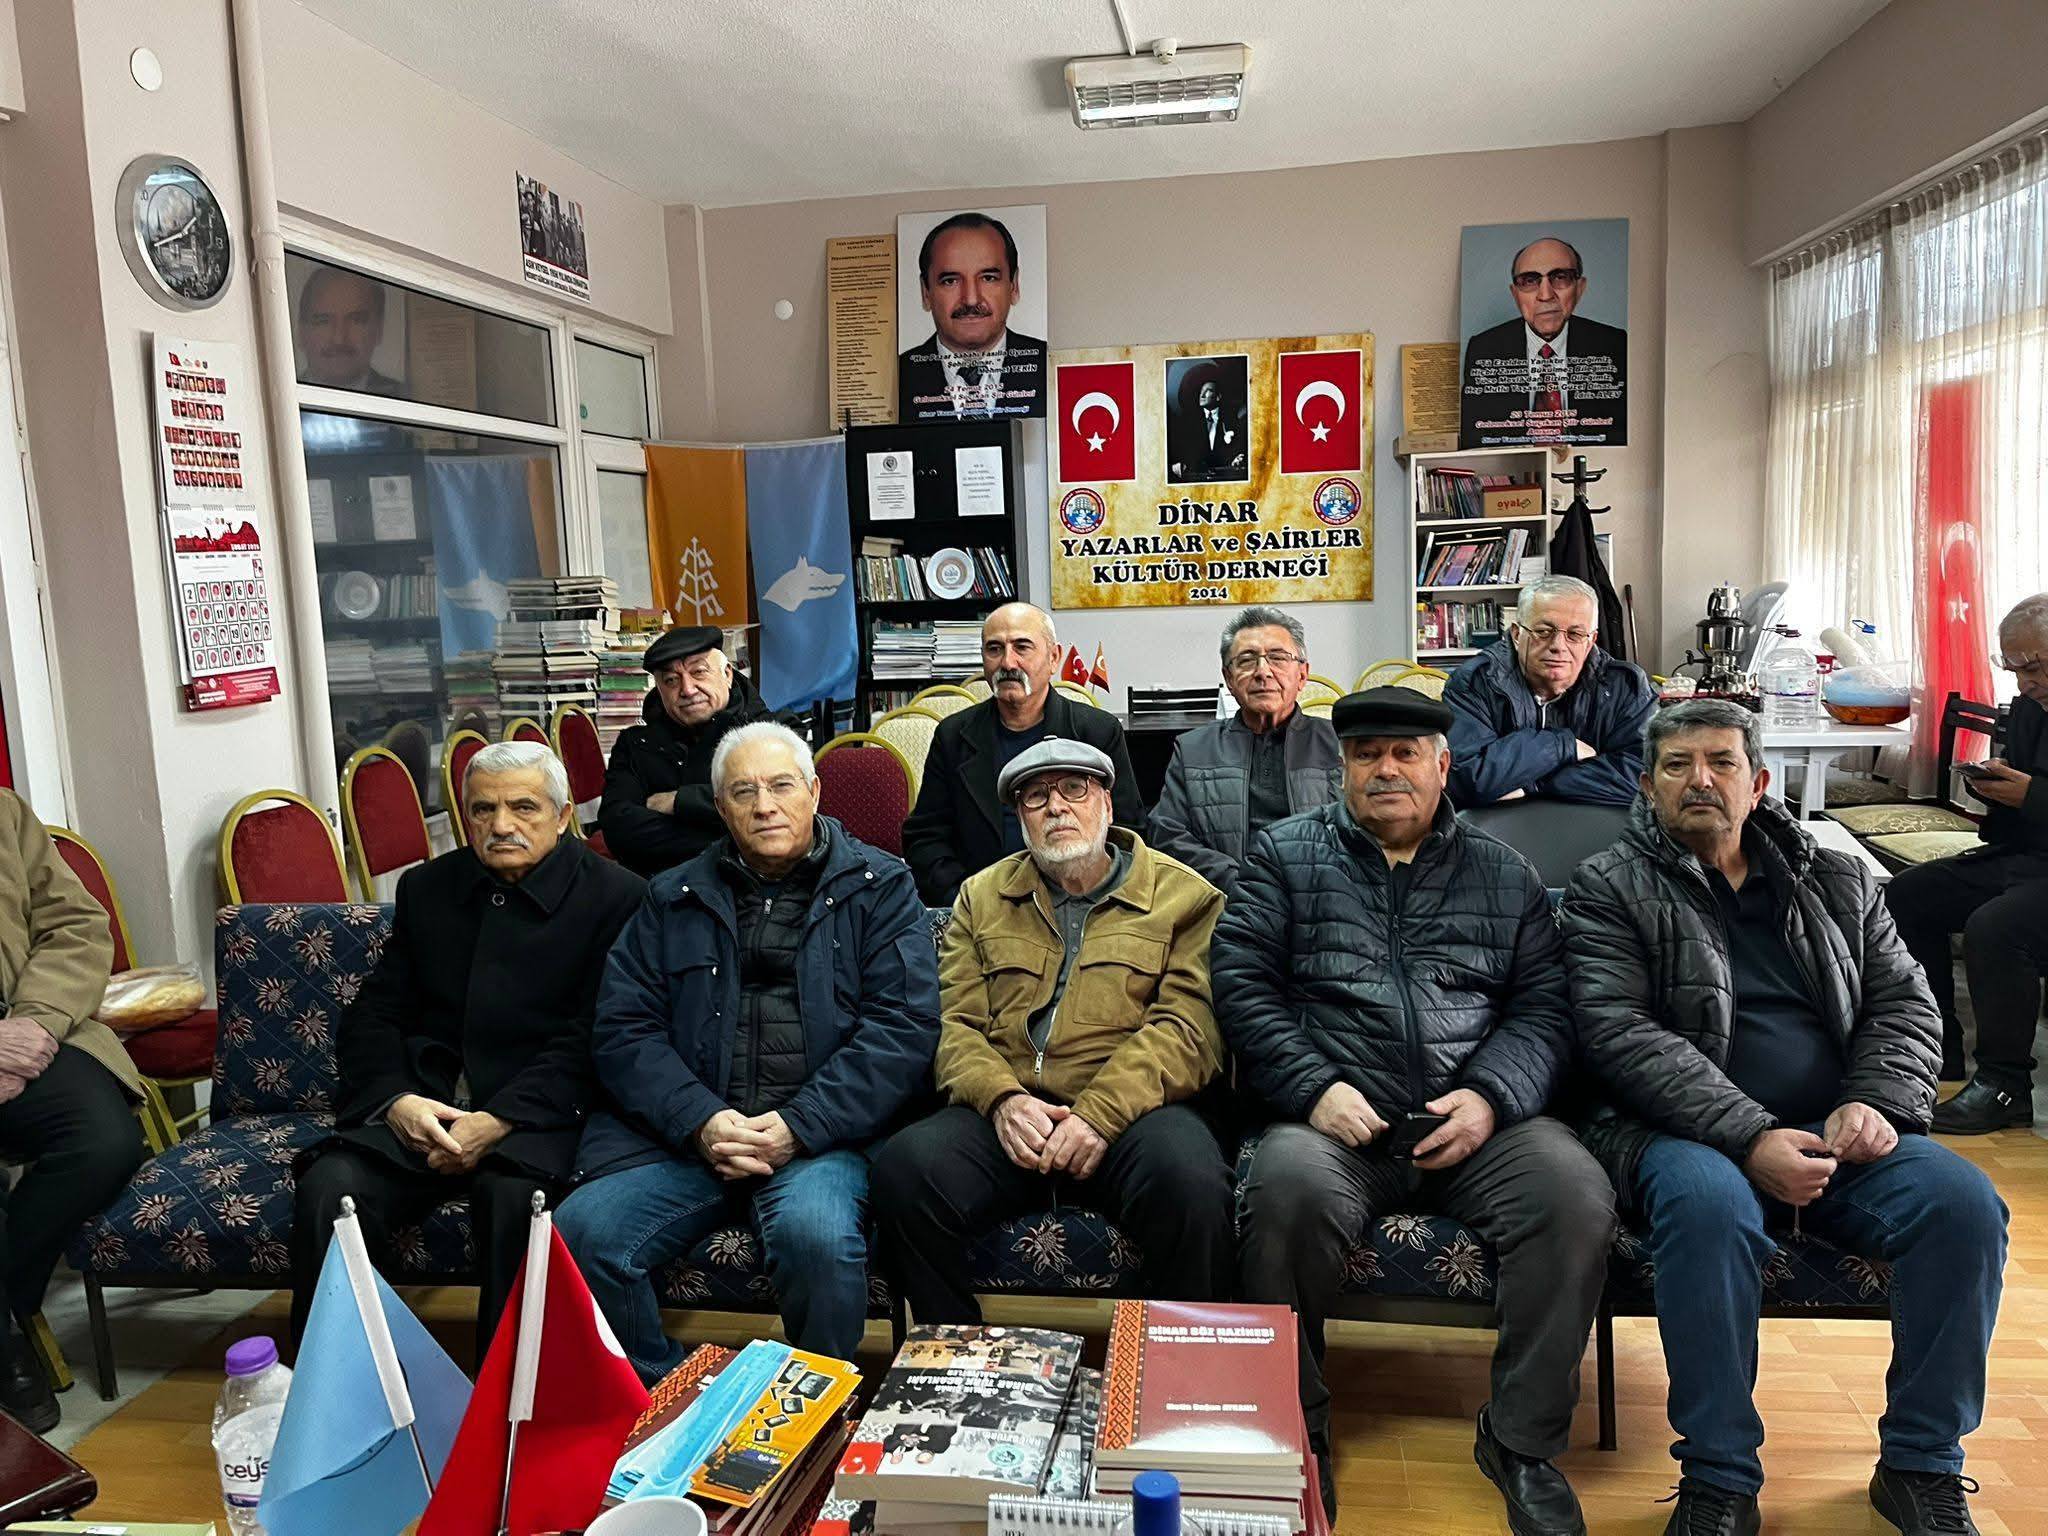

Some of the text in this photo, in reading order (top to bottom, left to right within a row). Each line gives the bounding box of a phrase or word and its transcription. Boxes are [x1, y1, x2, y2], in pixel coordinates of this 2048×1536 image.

[1493, 358, 1528, 366] Ezelden
[1498, 368, 1529, 376] Zaman
[1524, 410, 1554, 418] Temmuz
[1475, 420, 1525, 429] Geleneksel
[1158, 498, 1259, 526] DİNAR
[1061, 526, 1362, 557] YAZARLAR ve ŞAİRLER
[1093, 554, 1328, 584] KÜLTÜR DERNEĞİ
[187, 589, 192, 599] 2
[1190, 587, 1228, 600] 2014
[216, 610, 223, 619] 11
[1148, 1326, 1275, 1338] DİNAR SÖZ HAZİNESİ
[906, 1375, 1034, 1393] DİNAR TÜRK OCAKLARI
